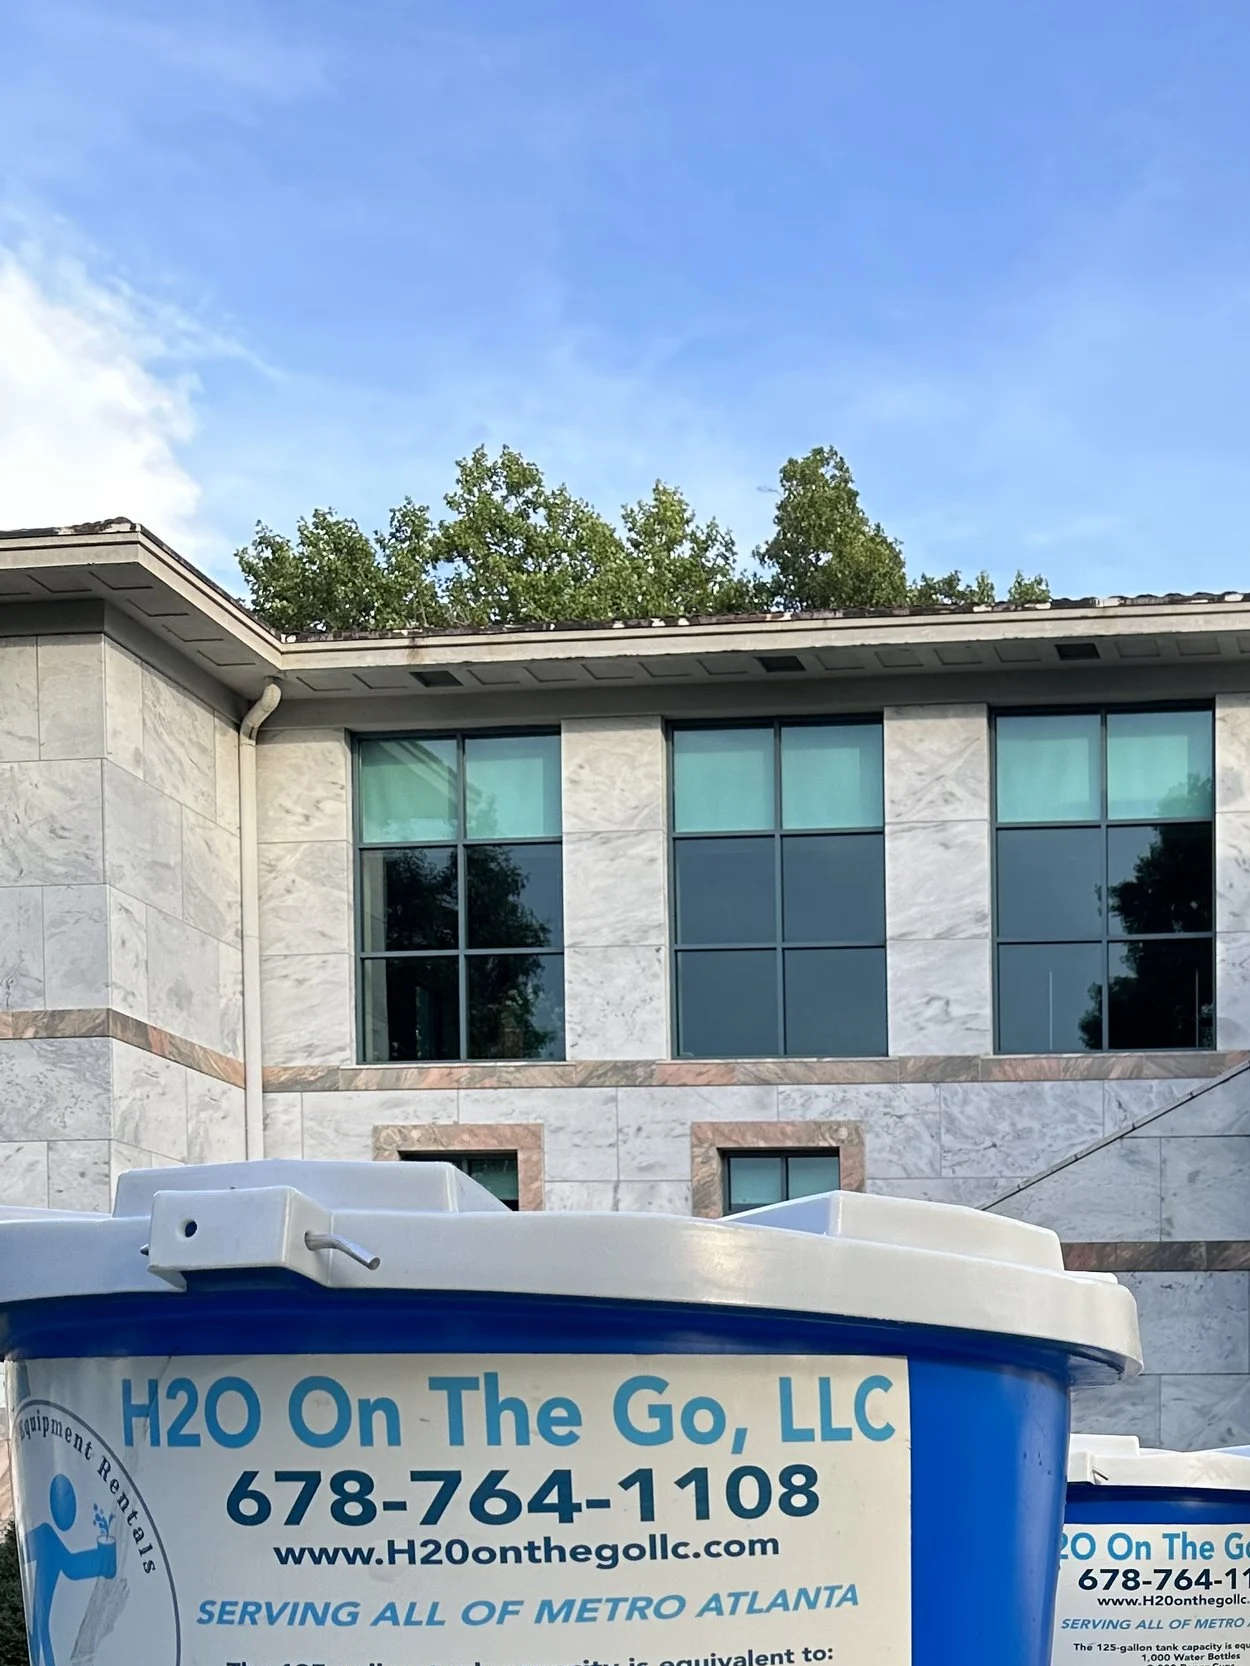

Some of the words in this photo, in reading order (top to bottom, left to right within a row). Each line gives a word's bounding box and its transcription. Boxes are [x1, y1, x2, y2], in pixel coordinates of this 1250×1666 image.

[122, 1376, 261, 1448] H2O
[289, 1376, 402, 1448] On
[428, 1372, 582, 1447] The
[613, 1375, 748, 1455] Go,
[779, 1374, 896, 1443] LLC
[19, 1409, 93, 1461] Equipment
[97, 1455, 156, 1574] Rentals
[226, 1464, 820, 1527] 678-764-1108
[1060, 1532, 1097, 1561] 2O
[1107, 1532, 1151, 1560] On
[1162, 1531, 1215, 1560] The
[196, 1600, 360, 1627] SERVING
[370, 1600, 446, 1627] ALL
[461, 1600, 523, 1627] OF
[534, 1594, 687, 1625] METRO
[695, 1583, 859, 1618] ATLANTA
[1061, 1618, 1131, 1630] SERVING
[1135, 1618, 1164, 1630] ALL
[1168, 1618, 1191, 1630] OF
[1194, 1617, 1245, 1629] METRO
[802, 1645, 834, 1664] to:
[1074, 1643, 1093, 1652] The
[1097, 1643, 1152, 1654] 125-gallon
[1155, 1643, 1179, 1652] tank
[1181, 1643, 1222, 1653] capacity
[1225, 1642, 1232, 1650] is
[1141, 1654, 1171, 1663] 1,000
[1174, 1653, 1205, 1662] Water
[1208, 1652, 1241, 1661] Bottles
